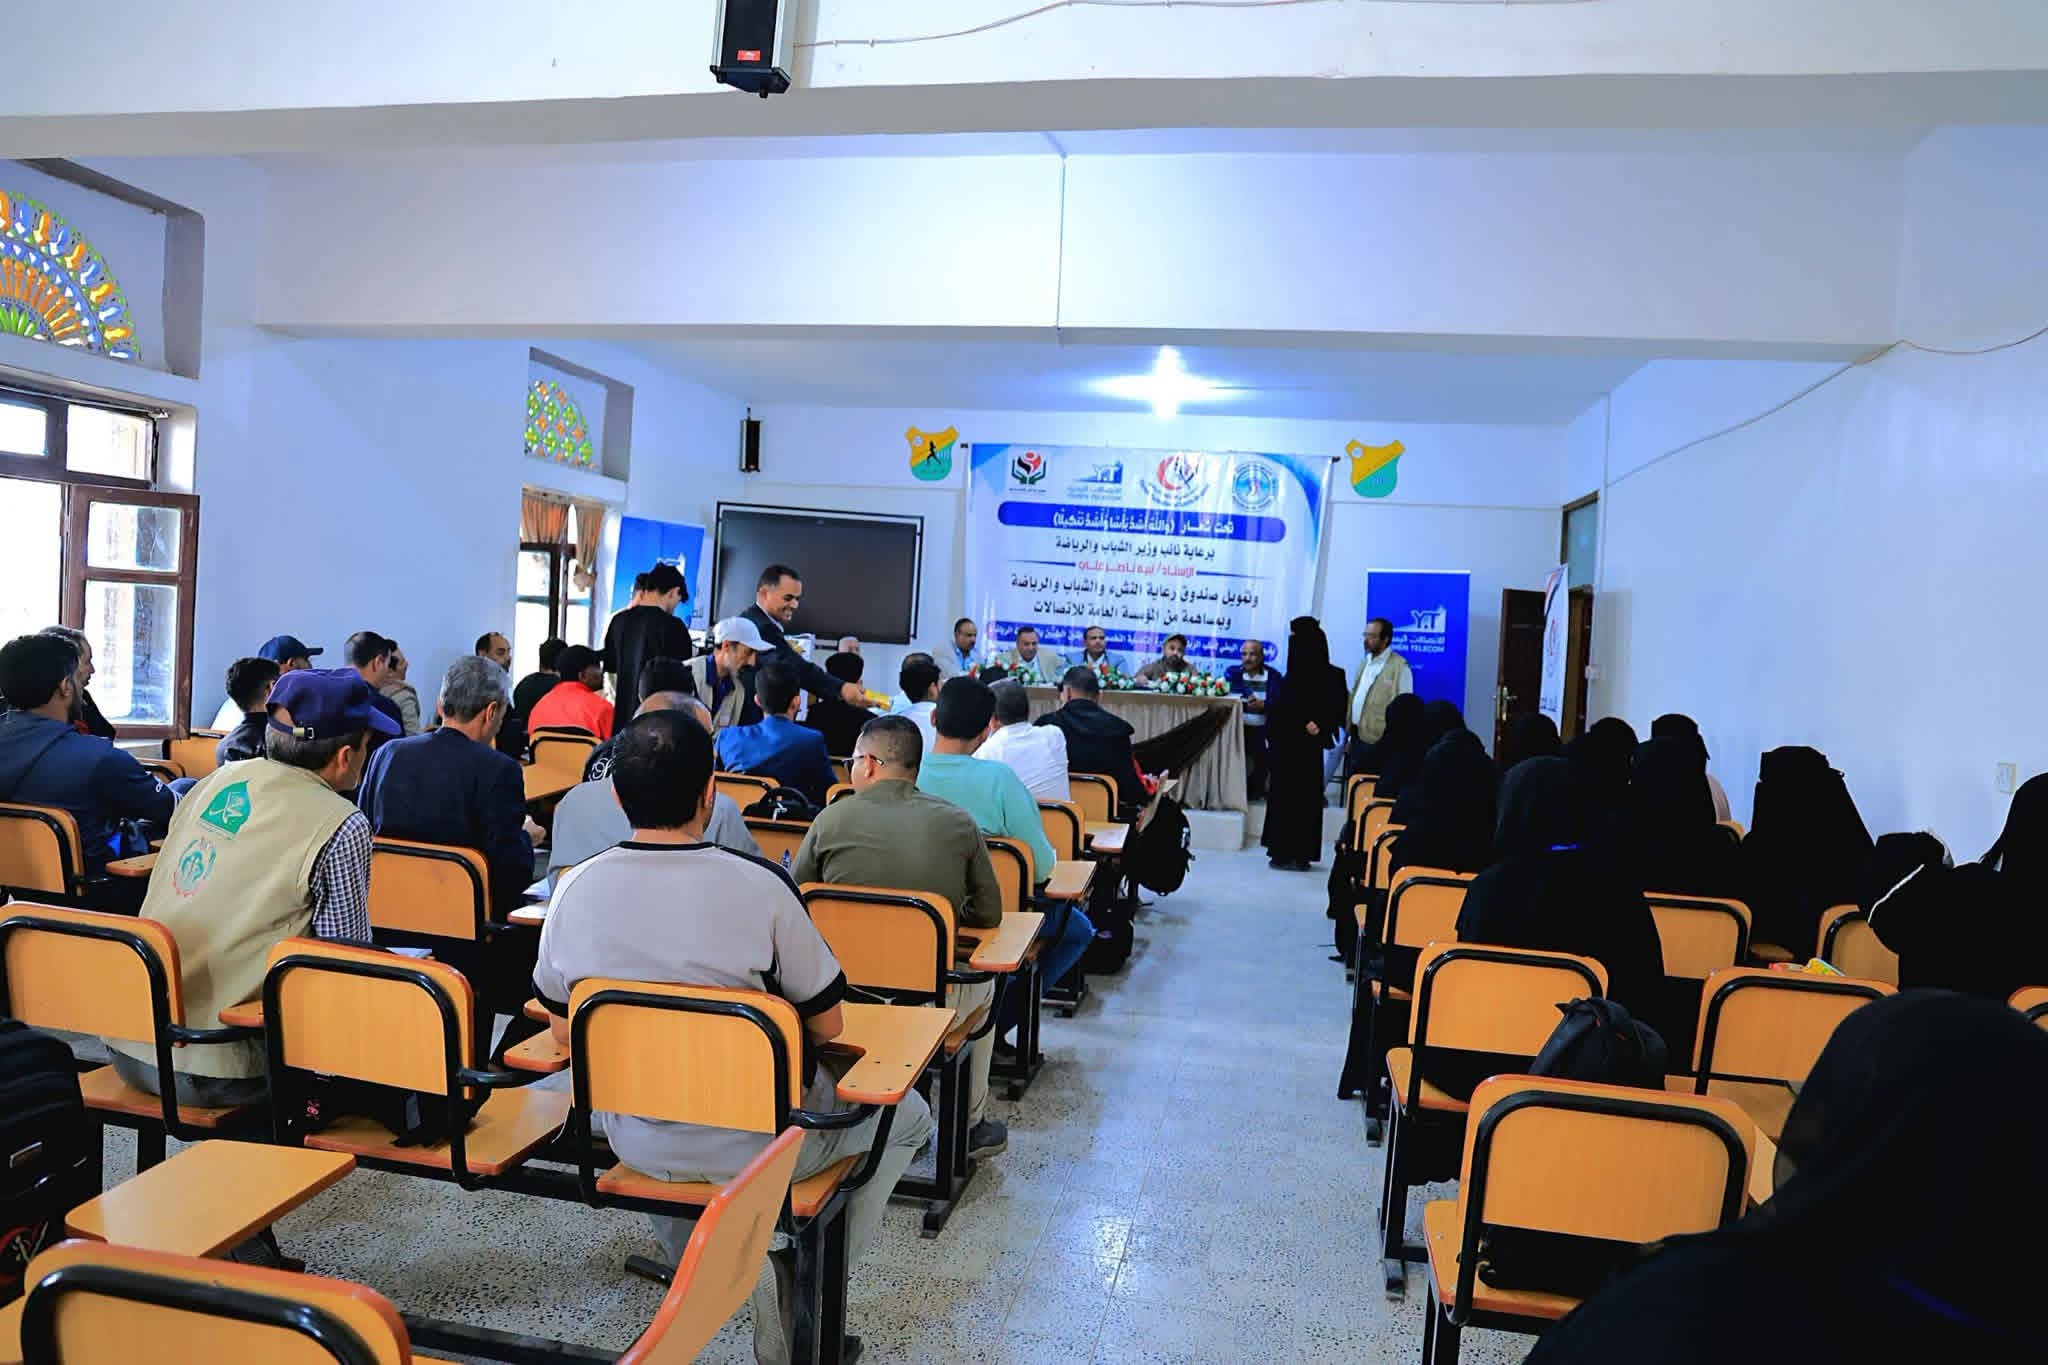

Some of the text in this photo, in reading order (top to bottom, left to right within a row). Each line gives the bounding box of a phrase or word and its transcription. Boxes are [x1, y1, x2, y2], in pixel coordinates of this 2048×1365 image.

[1214, 518, 1235, 534] تحت
[1056, 535, 1216, 561] برعاية نائب وزير الشباب والرياضة
[1011, 573, 1060, 593] والرياضة
[1063, 577, 1105, 597] والشباب
[1109, 579, 1142, 598] النشء
[1146, 581, 1177, 601] رعاية
[1180, 584, 1218, 603] صندوق
[1033, 599, 1232, 631] وبمساهمة من المؤسسة العامة للاتصالات
